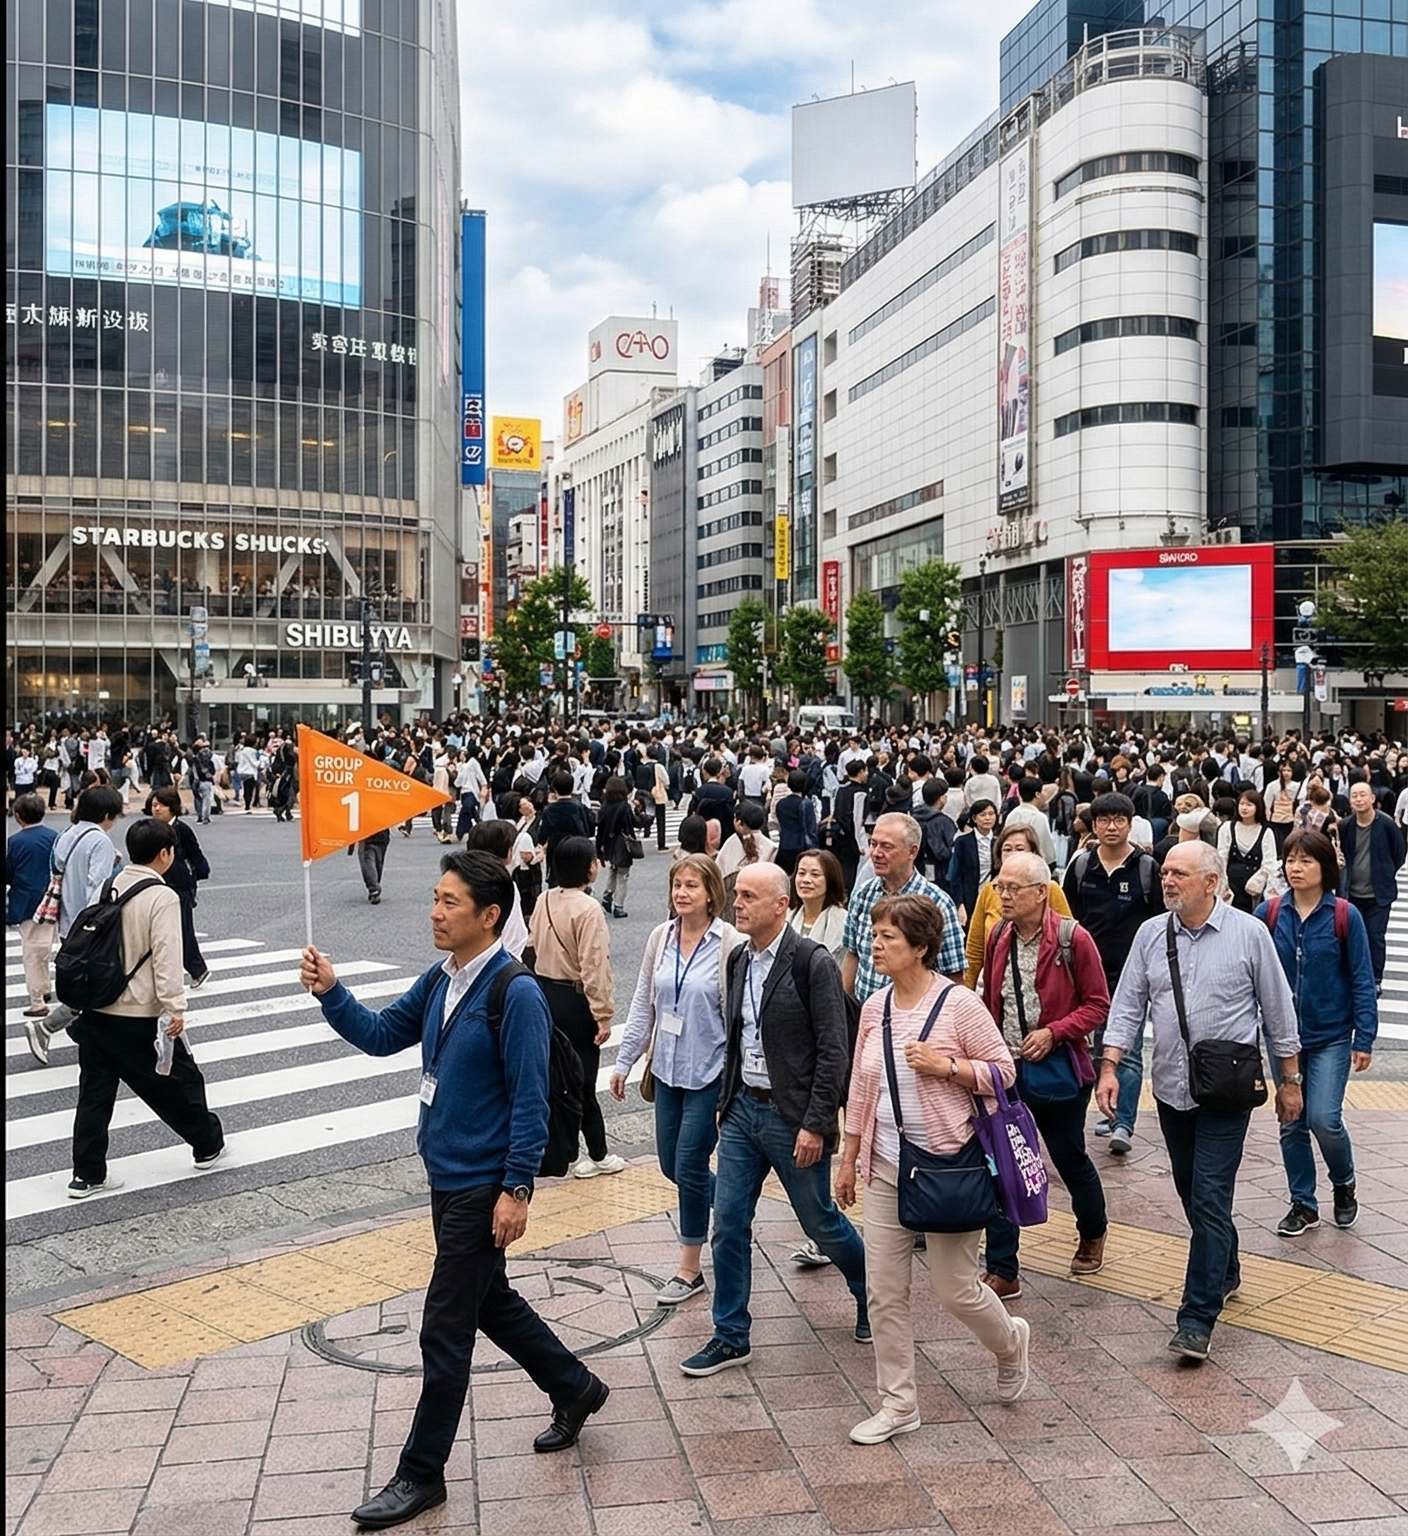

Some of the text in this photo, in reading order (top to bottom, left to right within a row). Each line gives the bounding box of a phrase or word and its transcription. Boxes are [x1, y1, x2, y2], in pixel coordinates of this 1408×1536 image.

[72, 526, 326, 555] STARBUCKS SHUCKS
[286, 623, 413, 649] SHIBUYYA
[314, 755, 364, 771] GROUP
[314, 769, 354, 784] TOUR
[366, 777, 411, 791] TOKYO
[340, 791, 360, 832] 1
